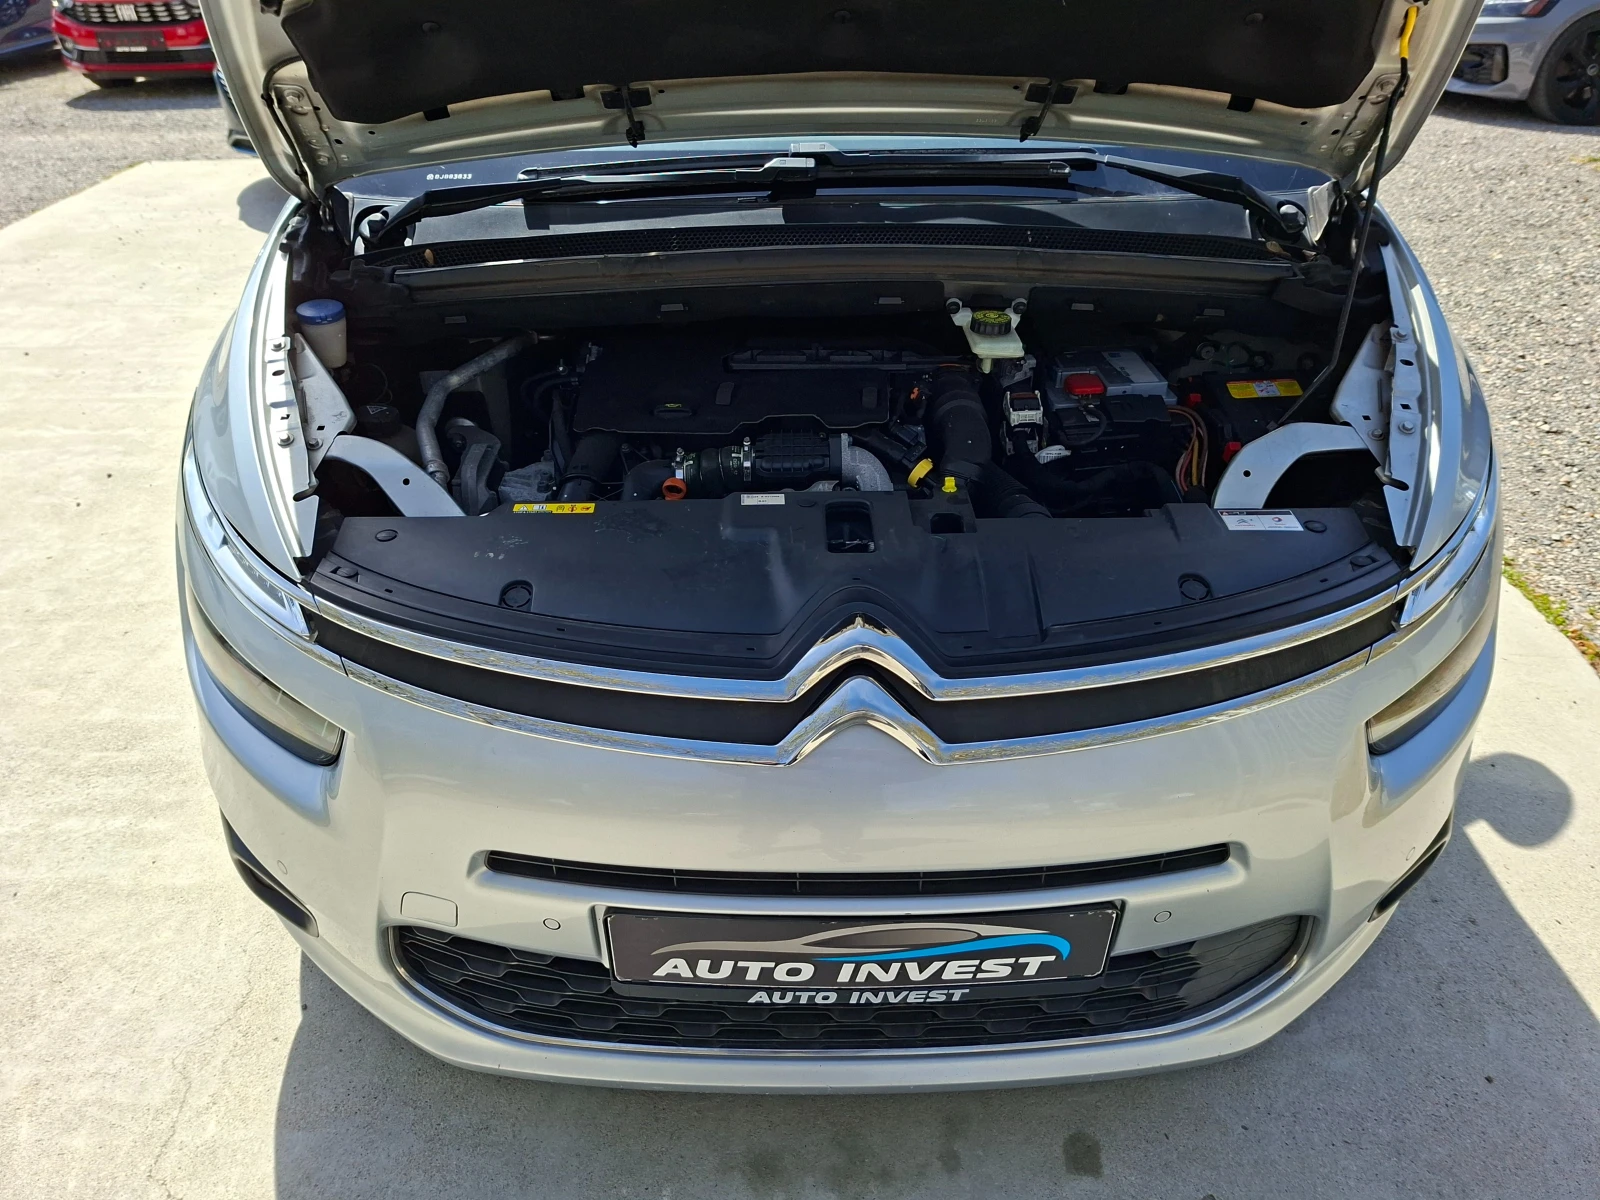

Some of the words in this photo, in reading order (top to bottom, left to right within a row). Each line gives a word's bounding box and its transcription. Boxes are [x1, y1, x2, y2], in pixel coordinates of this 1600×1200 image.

[652, 957, 815, 982] AUTO
[836, 955, 1056, 983] INVEST
[747, 991, 838, 1004] AUTO
[849, 989, 970, 1004] INVEST
